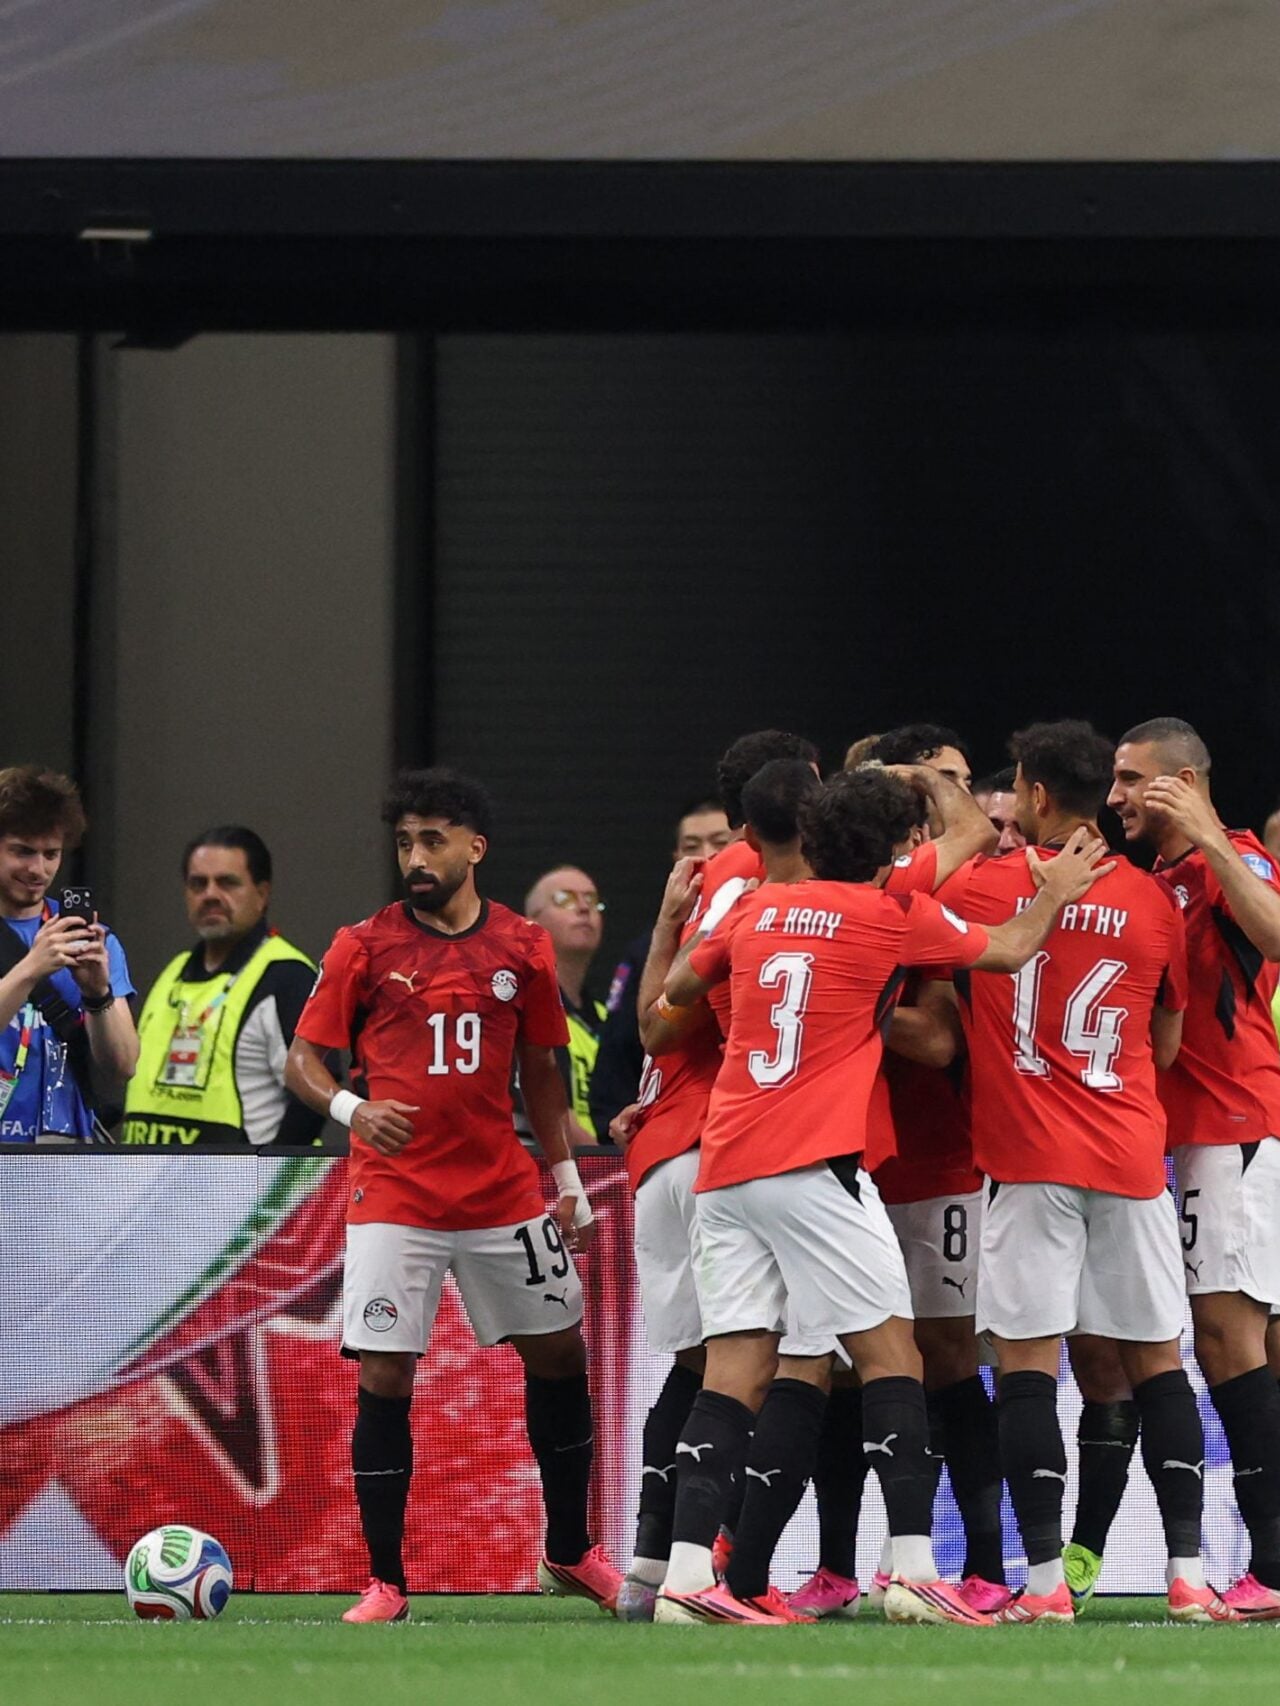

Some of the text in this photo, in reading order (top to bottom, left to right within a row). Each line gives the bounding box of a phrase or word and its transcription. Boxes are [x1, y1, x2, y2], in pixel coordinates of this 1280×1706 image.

[755, 906, 842, 939] M. HANY
[1060, 903, 1128, 938] ATHY
[427, 1012, 481, 1075] 19
[748, 951, 815, 1089] 3
[1010, 950, 1129, 1093] 14
[943, 1204, 967, 1262] 8
[1181, 1188, 1200, 1251] 5
[514, 1217, 569, 1286] 19
